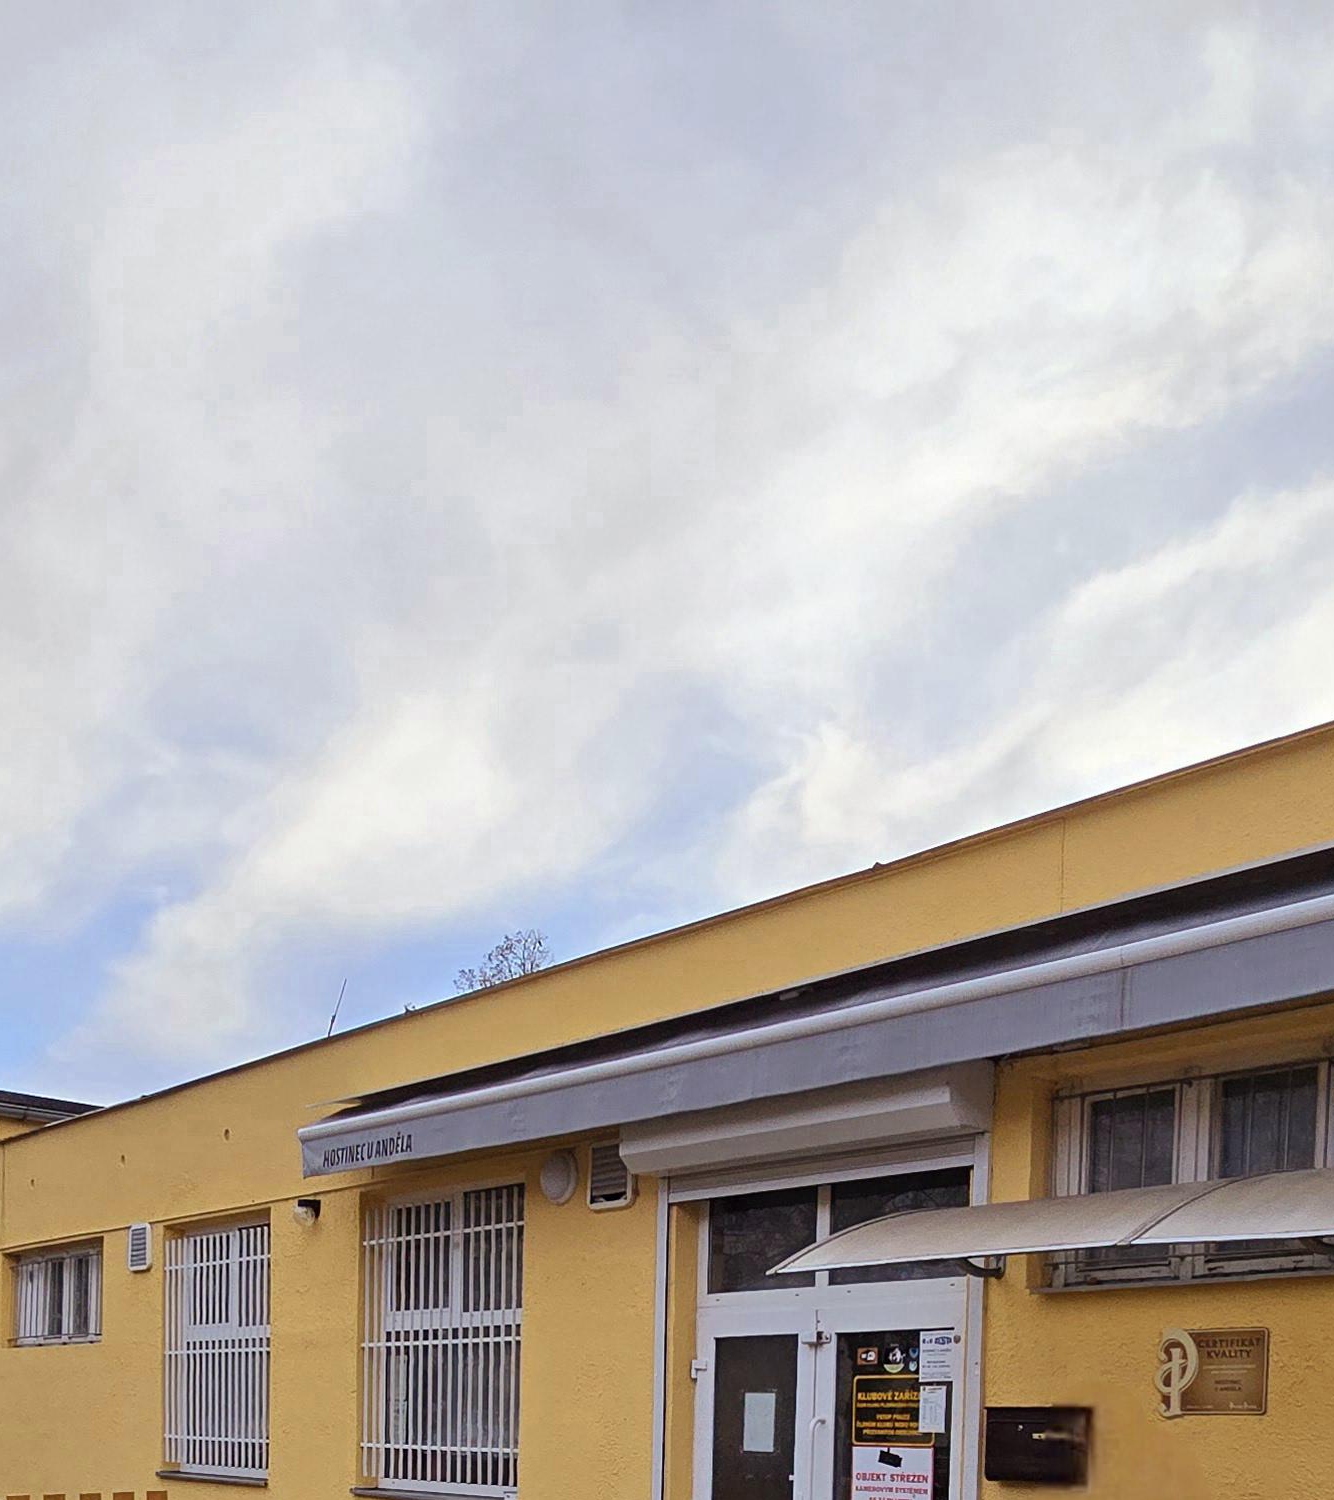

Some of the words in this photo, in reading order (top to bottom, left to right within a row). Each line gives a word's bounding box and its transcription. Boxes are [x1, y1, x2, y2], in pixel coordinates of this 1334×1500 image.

[322, 1145, 365, 1168] HOSTINEC
[366, 1141, 375, 1161] U
[1206, 1348, 1253, 1360] KVALITY
[855, 1472, 886, 1482] OBJEKT
